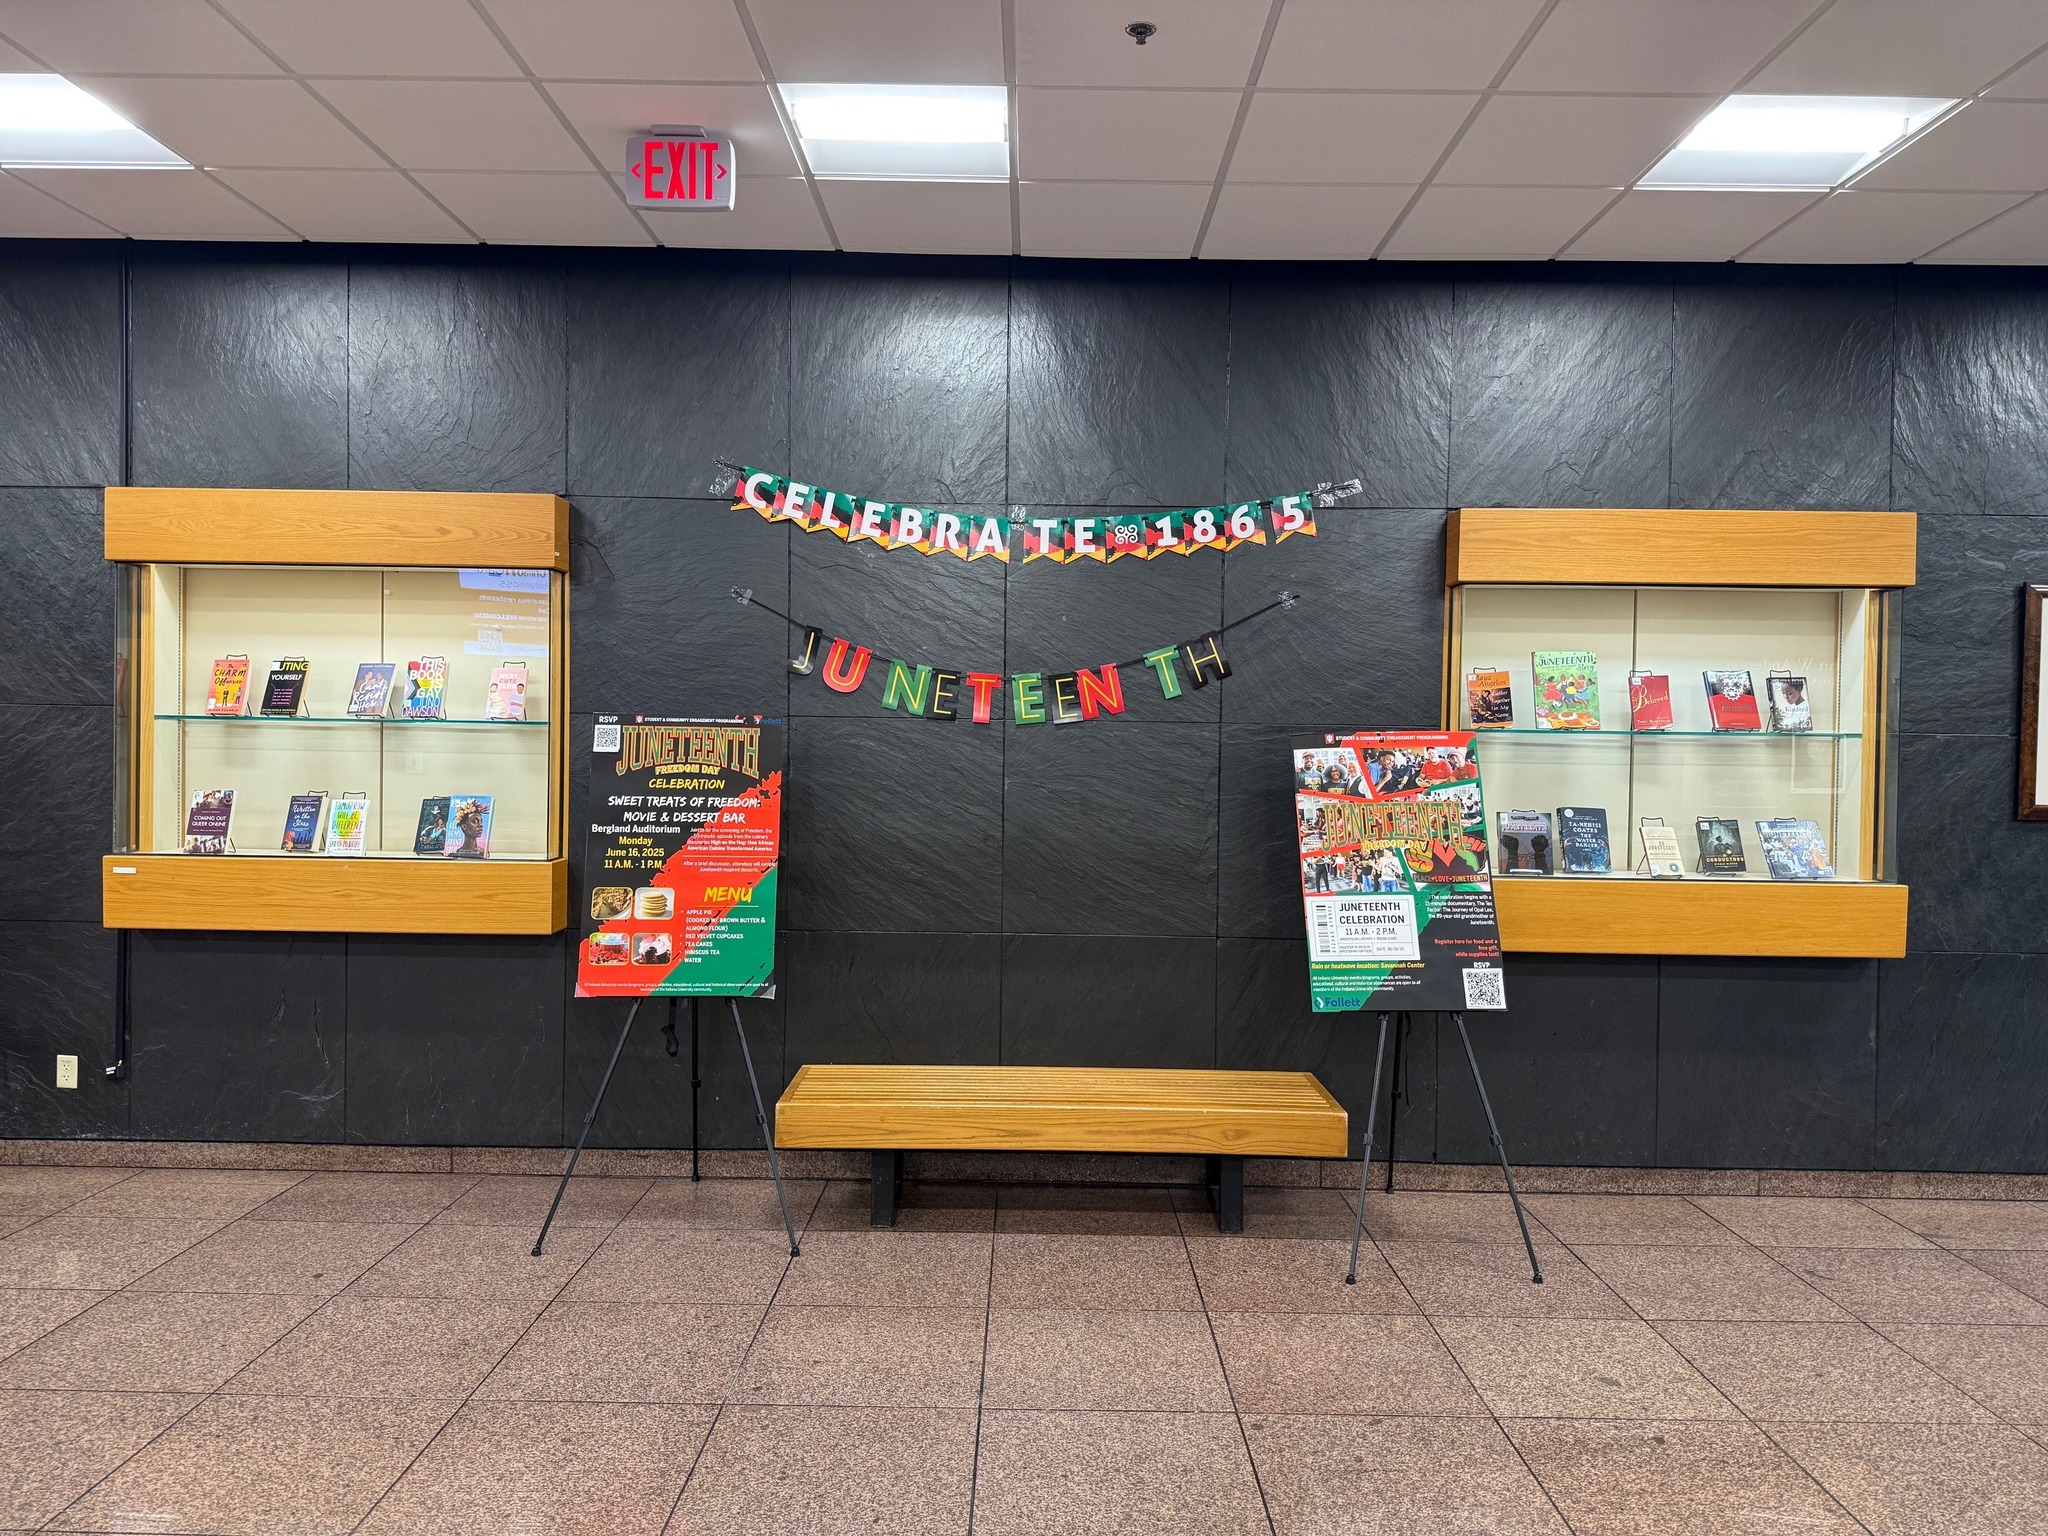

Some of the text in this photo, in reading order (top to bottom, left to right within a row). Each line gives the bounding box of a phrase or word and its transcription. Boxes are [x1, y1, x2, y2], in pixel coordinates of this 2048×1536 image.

[644, 141, 719, 201] EXIT
[744, 473, 1305, 553] CELEBRATE 1865
[419, 661, 445, 670] THIS
[1539, 655, 1594, 666] JUNETEENTH
[279, 662, 310, 671] UTING
[214, 669, 246, 677] CHARM
[410, 670, 444, 680] BOOK
[788, 626, 1233, 725] JUNETEENTH
[430, 679, 443, 688] IS
[416, 688, 441, 698] GAY
[418, 698, 440, 708] JUNO
[1631, 685, 1669, 712] Beloved
[402, 707, 439, 716] DAWSON
[616, 726, 760, 779] JUNETEENTH
[655, 765, 721, 776] FREEDOM DAY
[649, 779, 725, 790] CELEBRATION
[608, 796, 761, 808] SWEET TREATS OF FREEDOM:
[623, 812, 746, 824] MOVIE & DESSERT BAR
[592, 824, 680, 834] Bergland Auditorium
[1322, 802, 1466, 852] JUNETEENTH
[619, 836, 654, 846] Monday
[1363, 840, 1426, 850] FREEDOM DAY
[605, 848, 664, 858] June 16, 2025
[604, 860, 612, 868] 11
[614, 860, 634, 868] A.M.
[640, 860, 645, 868] 1
[704, 886, 752, 902] MENU
[1339, 902, 1400, 912] JUNETEENTH
[1340, 915, 1404, 924] CELEBRATION
[1346, 928, 1352, 936] 11
[1354, 928, 1370, 936] A.M.
[1382, 928, 1398, 936] P.M.
[1325, 998, 1361, 1008] Follett
